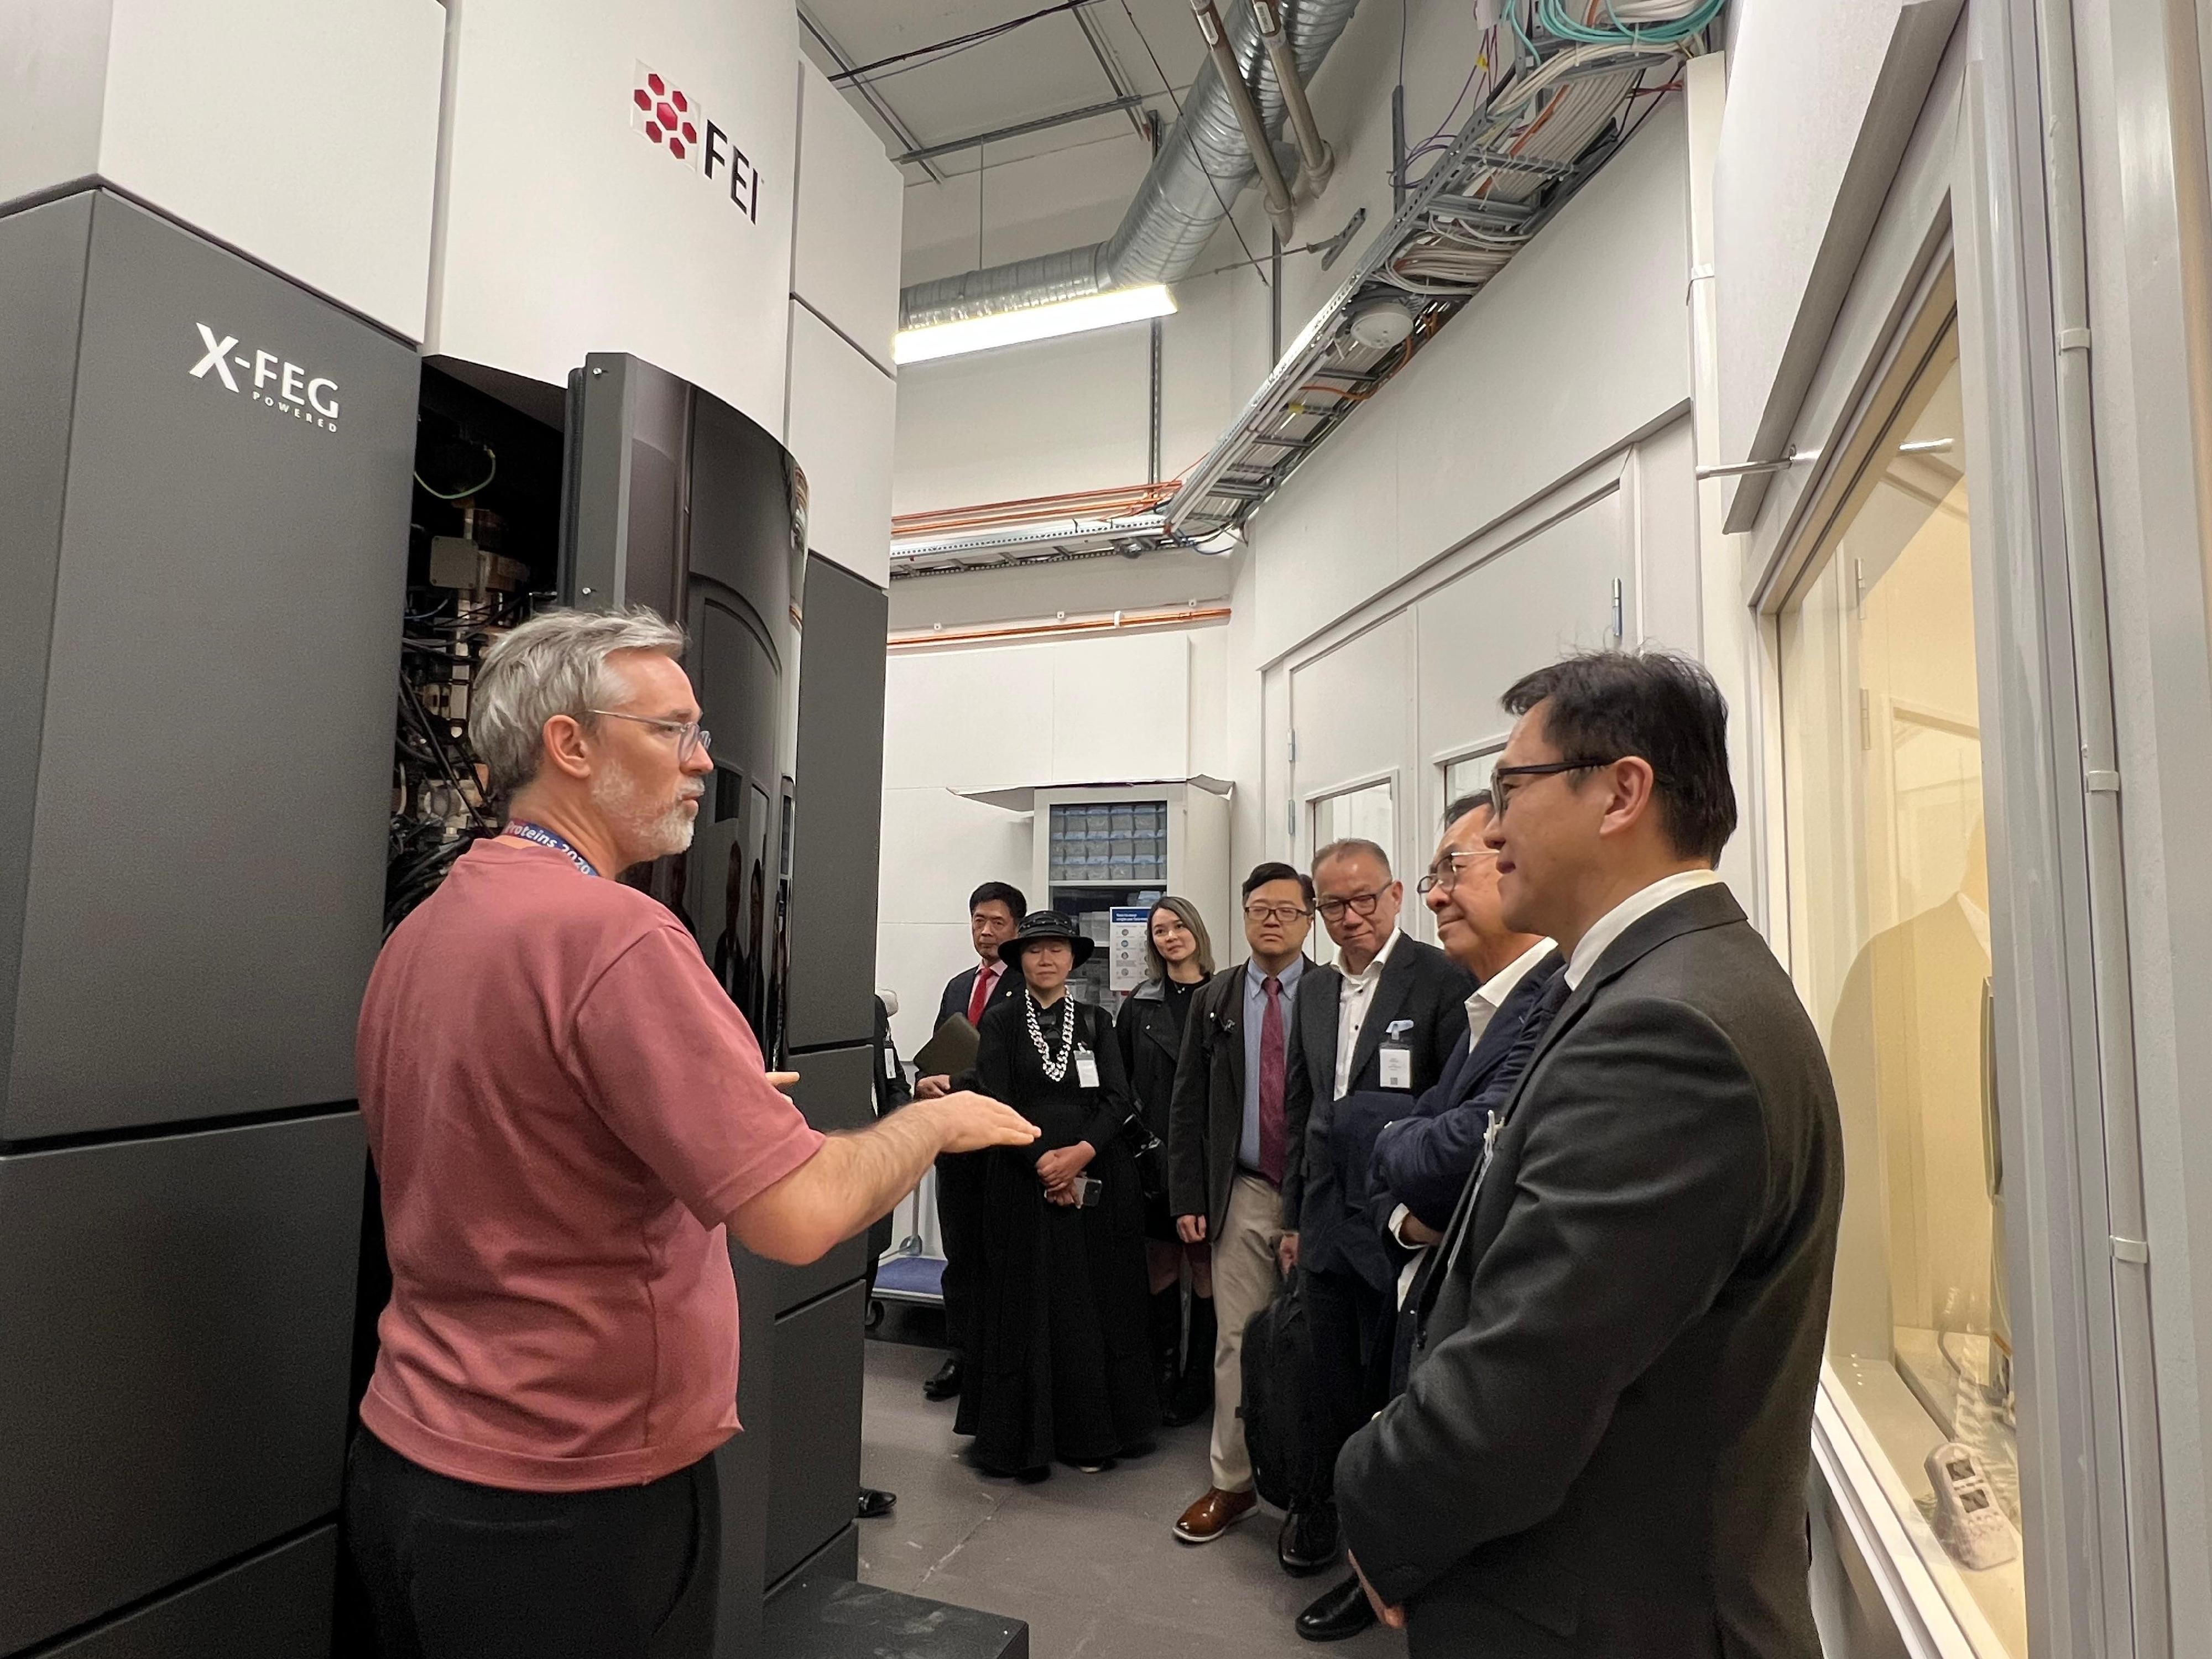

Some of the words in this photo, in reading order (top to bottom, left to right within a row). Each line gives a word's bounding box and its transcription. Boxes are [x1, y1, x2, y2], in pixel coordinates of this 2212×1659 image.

[705, 119, 758, 225] FEI
[189, 322, 340, 419] X-FEG
[252, 390, 337, 432] POWERED
